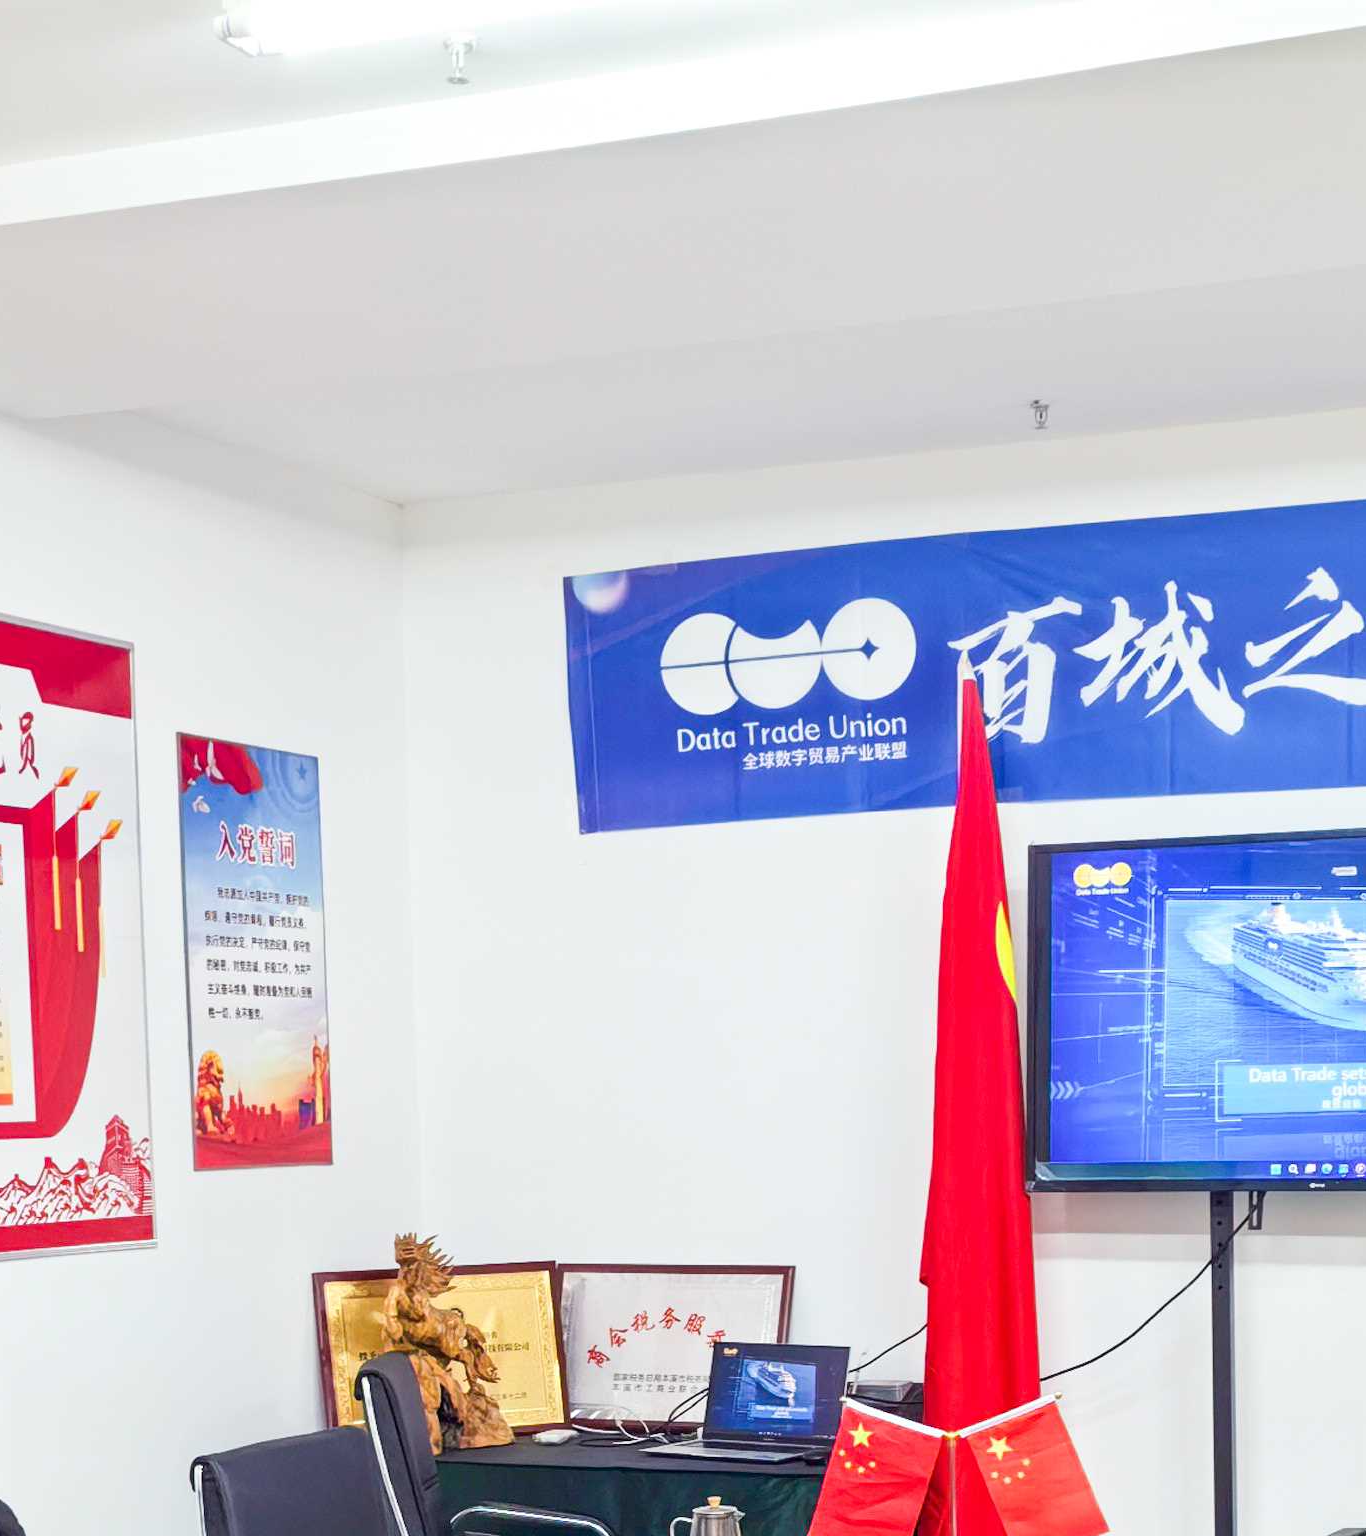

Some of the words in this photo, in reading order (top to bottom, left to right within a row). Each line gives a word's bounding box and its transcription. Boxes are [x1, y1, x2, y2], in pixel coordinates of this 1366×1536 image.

[677, 728, 736, 752] Data
[743, 718, 820, 746] Trade
[828, 713, 907, 739] Union
[743, 741, 907, 770] 全球数字贸易产业联盟
[218, 823, 295, 868] 入党誓词
[1248, 1067, 1287, 1083] Data
[1291, 1066, 1335, 1082] Trade
